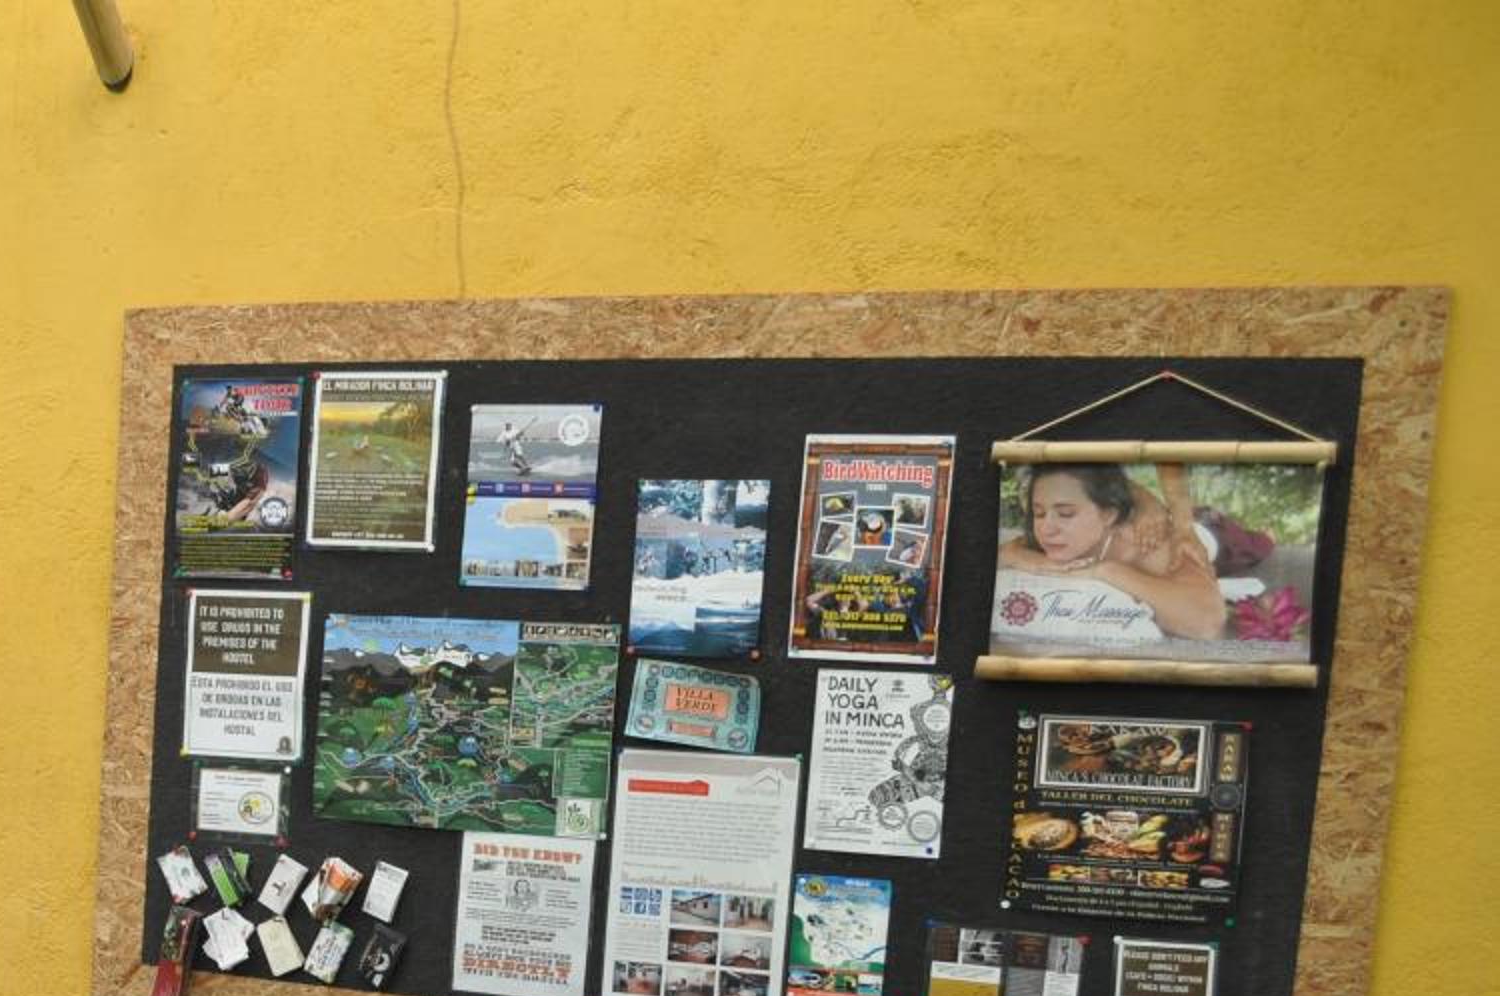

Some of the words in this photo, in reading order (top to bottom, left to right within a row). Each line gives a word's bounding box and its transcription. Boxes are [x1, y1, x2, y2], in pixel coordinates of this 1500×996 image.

[823, 459, 933, 489] BirdWatching
[200, 606, 206, 617] IT
[220, 608, 270, 619] PROHIBITED
[273, 608, 284, 620] TO
[201, 621, 218, 633] USE
[222, 622, 250, 634] DRUGS
[254, 622, 262, 634] IN
[266, 624, 281, 634] THE
[202, 636, 246, 649] PREMISES
[248, 638, 258, 649] OF
[261, 638, 277, 650] THE
[222, 652, 255, 664] HOSTEL
[216, 678, 260, 690] PROHIBIDO
[262, 681, 272, 692] EL
[828, 676, 878, 692] DAILY
[202, 693, 213, 704] DE
[216, 694, 250, 706] DROGAS
[252, 695, 262, 706] EN
[266, 697, 282, 707] LAS
[676, 688, 713, 700] VILLA
[828, 694, 878, 710] YOGA
[200, 708, 265, 720] INSTALACIONES
[268, 711, 282, 722] DEL
[825, 711, 840, 725] IN
[846, 712, 904, 728] MINCA
[224, 724, 256, 736] HOSTAL
[474, 844, 500, 856] DID
[504, 846, 530, 858] YOU
[534, 849, 581, 864] KNOW?
